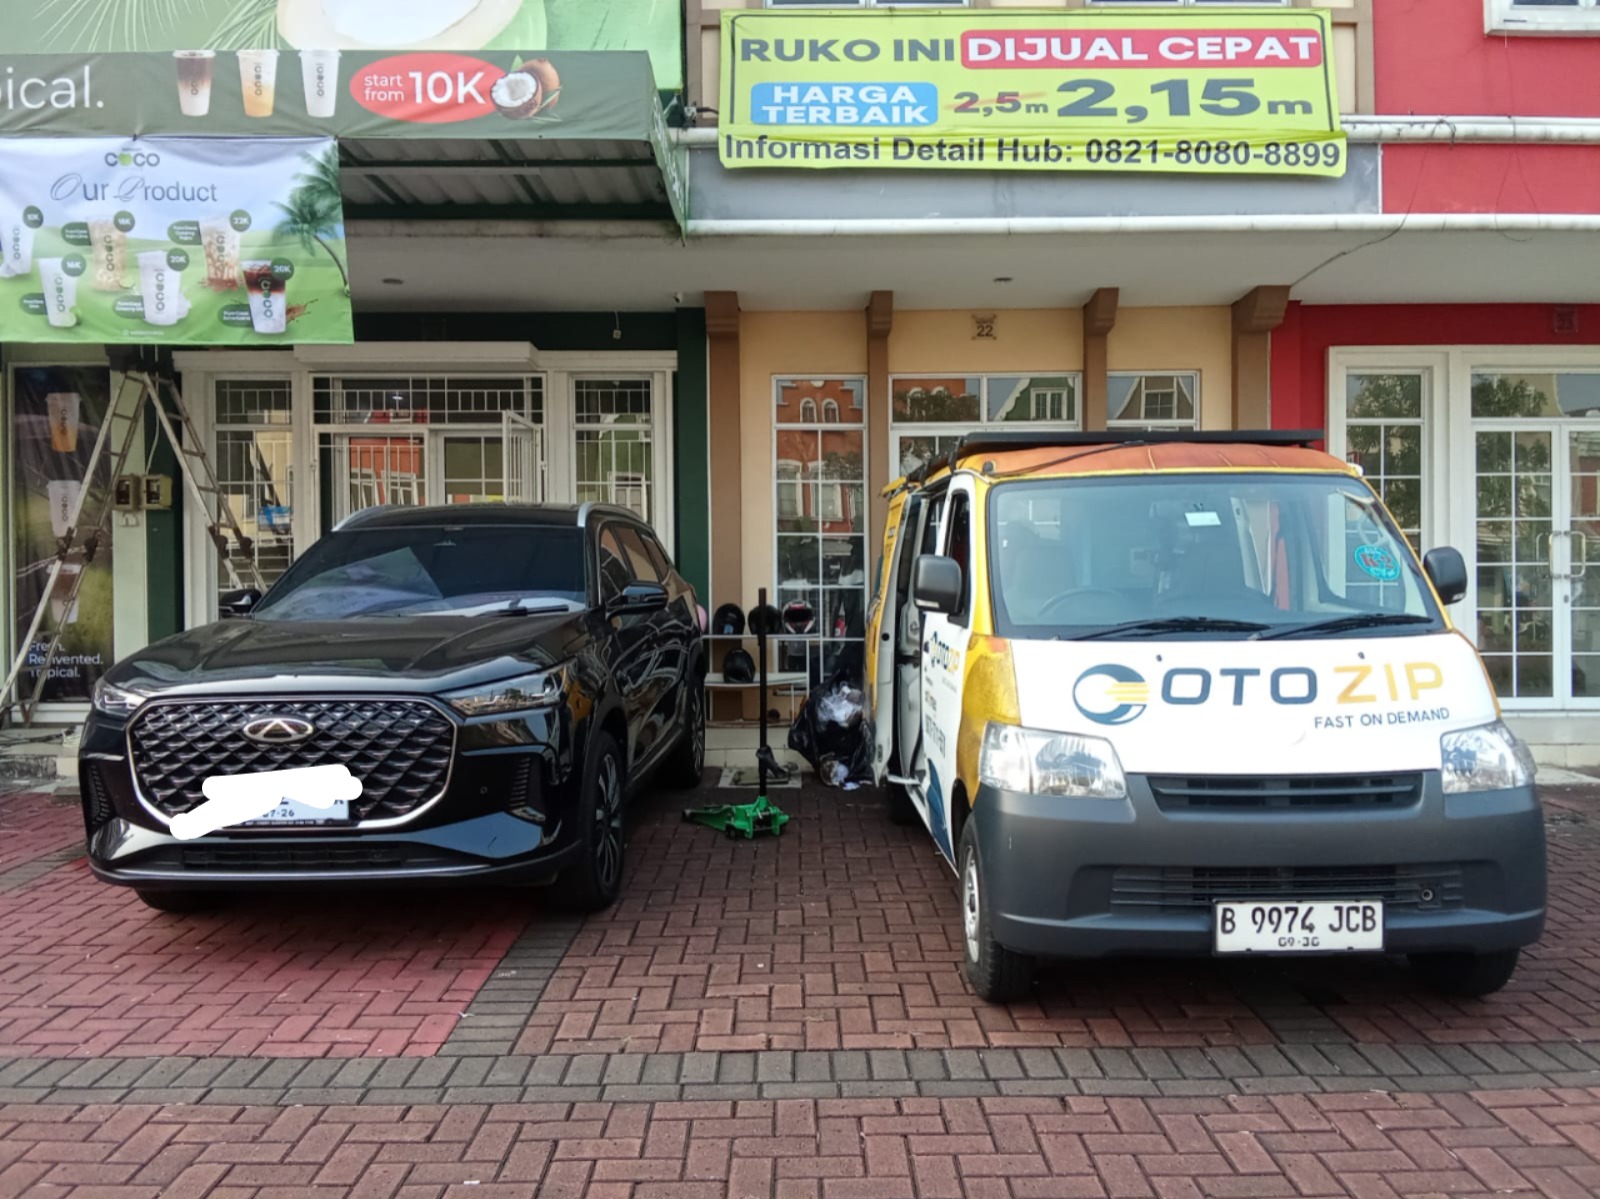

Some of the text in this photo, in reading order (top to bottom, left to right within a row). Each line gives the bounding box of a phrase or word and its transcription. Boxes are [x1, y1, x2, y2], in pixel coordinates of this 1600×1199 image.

[741, 37, 1317, 61] RUKO INI DIJUAL CEPAT
[364, 74, 403, 87] start
[409, 71, 486, 104] 10K
[364, 87, 404, 101] from
[773, 86, 917, 104] HARGA
[762, 105, 928, 124] TERBAIK
[725, 134, 1340, 167] Informasi Detail Hub: 0821-8080-8899
[50, 173, 218, 202] Our Product
[976, 324, 993, 337] 22
[1314, 706, 1450, 729] FAST ON DEMAND
[1220, 905, 1376, 934] B 9974 JCB
